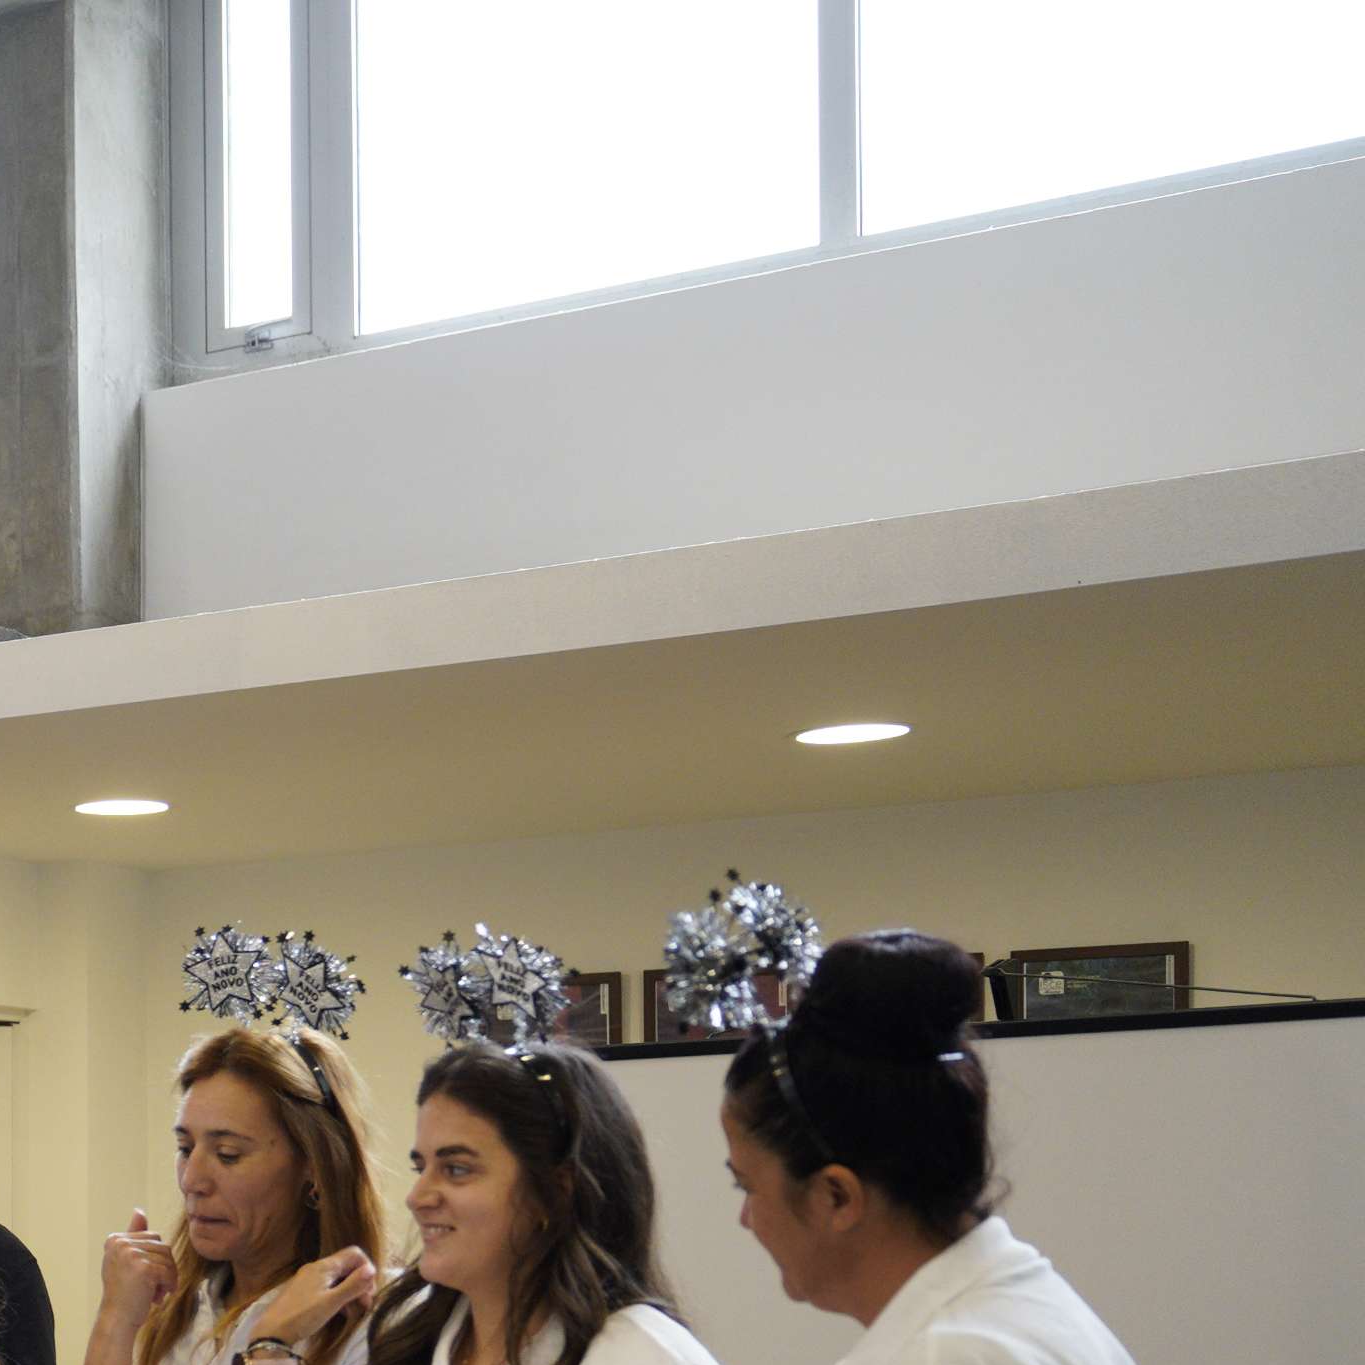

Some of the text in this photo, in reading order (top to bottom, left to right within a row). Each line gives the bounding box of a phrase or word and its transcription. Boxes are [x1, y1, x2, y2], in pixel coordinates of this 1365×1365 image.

[207, 954, 238, 970] FELIZ
[213, 966, 238, 980] ANO
[212, 977, 245, 993] NOVO
[296, 980, 320, 1003] ANO
[289, 985, 318, 1014] NOVO
